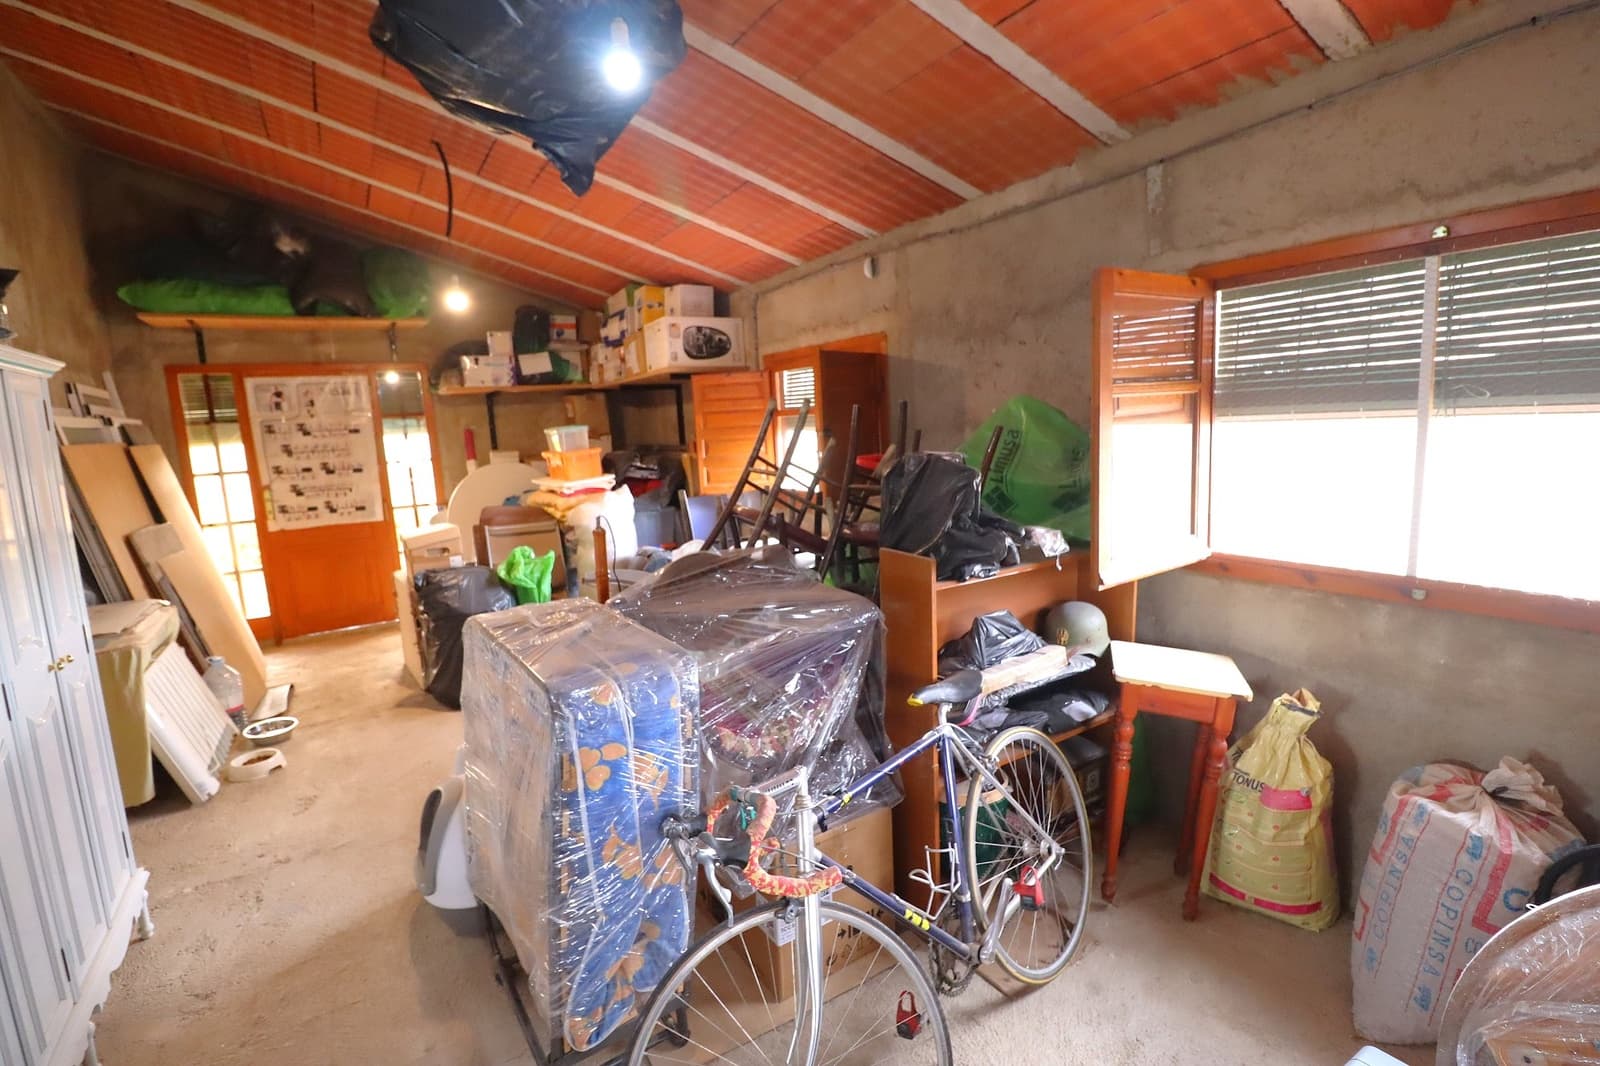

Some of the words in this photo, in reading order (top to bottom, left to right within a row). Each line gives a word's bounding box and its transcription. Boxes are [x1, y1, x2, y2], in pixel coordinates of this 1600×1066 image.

[1232, 771, 1265, 793] TONUS
[1374, 835, 1415, 940] COPINSA
[1422, 868, 1473, 977] COPINSA
